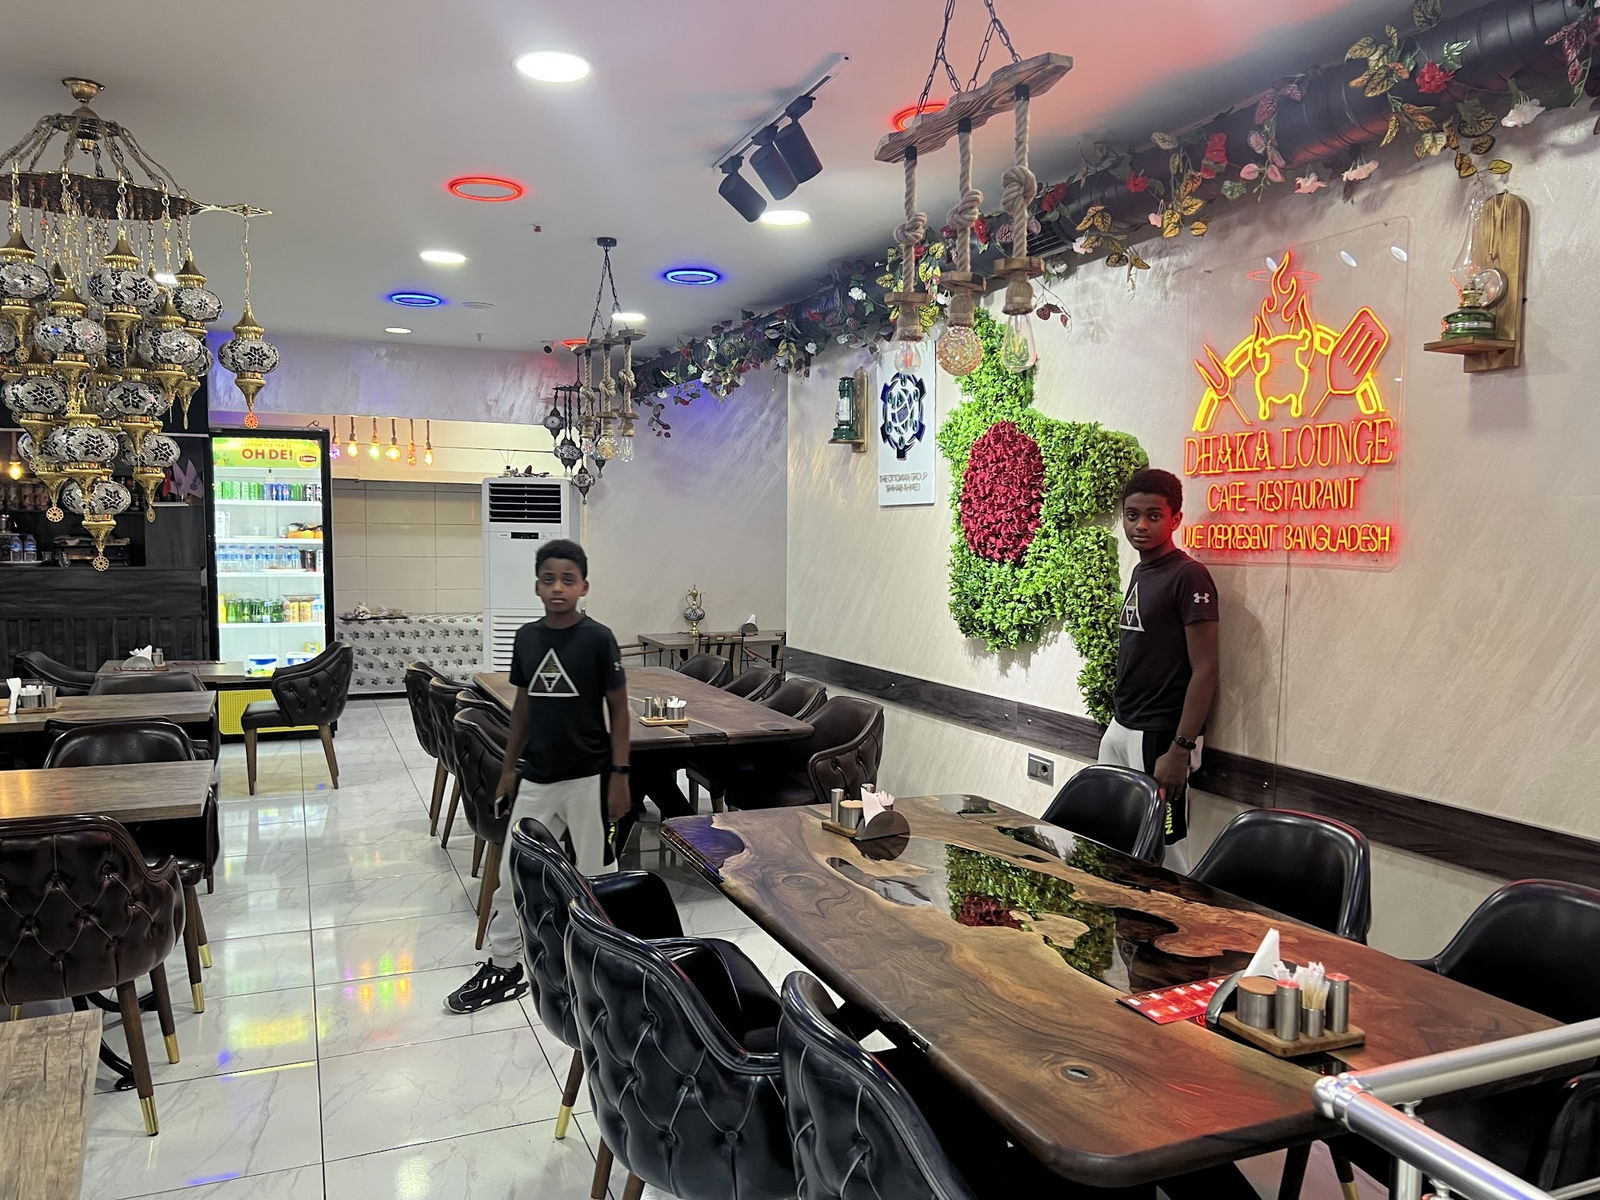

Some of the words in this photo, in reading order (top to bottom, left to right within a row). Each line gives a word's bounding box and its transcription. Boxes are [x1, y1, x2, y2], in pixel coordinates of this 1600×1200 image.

[241, 448, 265, 459] OH
[268, 449, 293, 460] DE!
[1183, 429, 1276, 476] DHAKA
[1280, 418, 1395, 469] LOUNGE
[1207, 477, 1360, 513] CAFE-RESTAURANT
[1182, 524, 1206, 548] WE
[1207, 523, 1278, 550] REPRESENT
[1283, 523, 1391, 552] BANGLADESH
